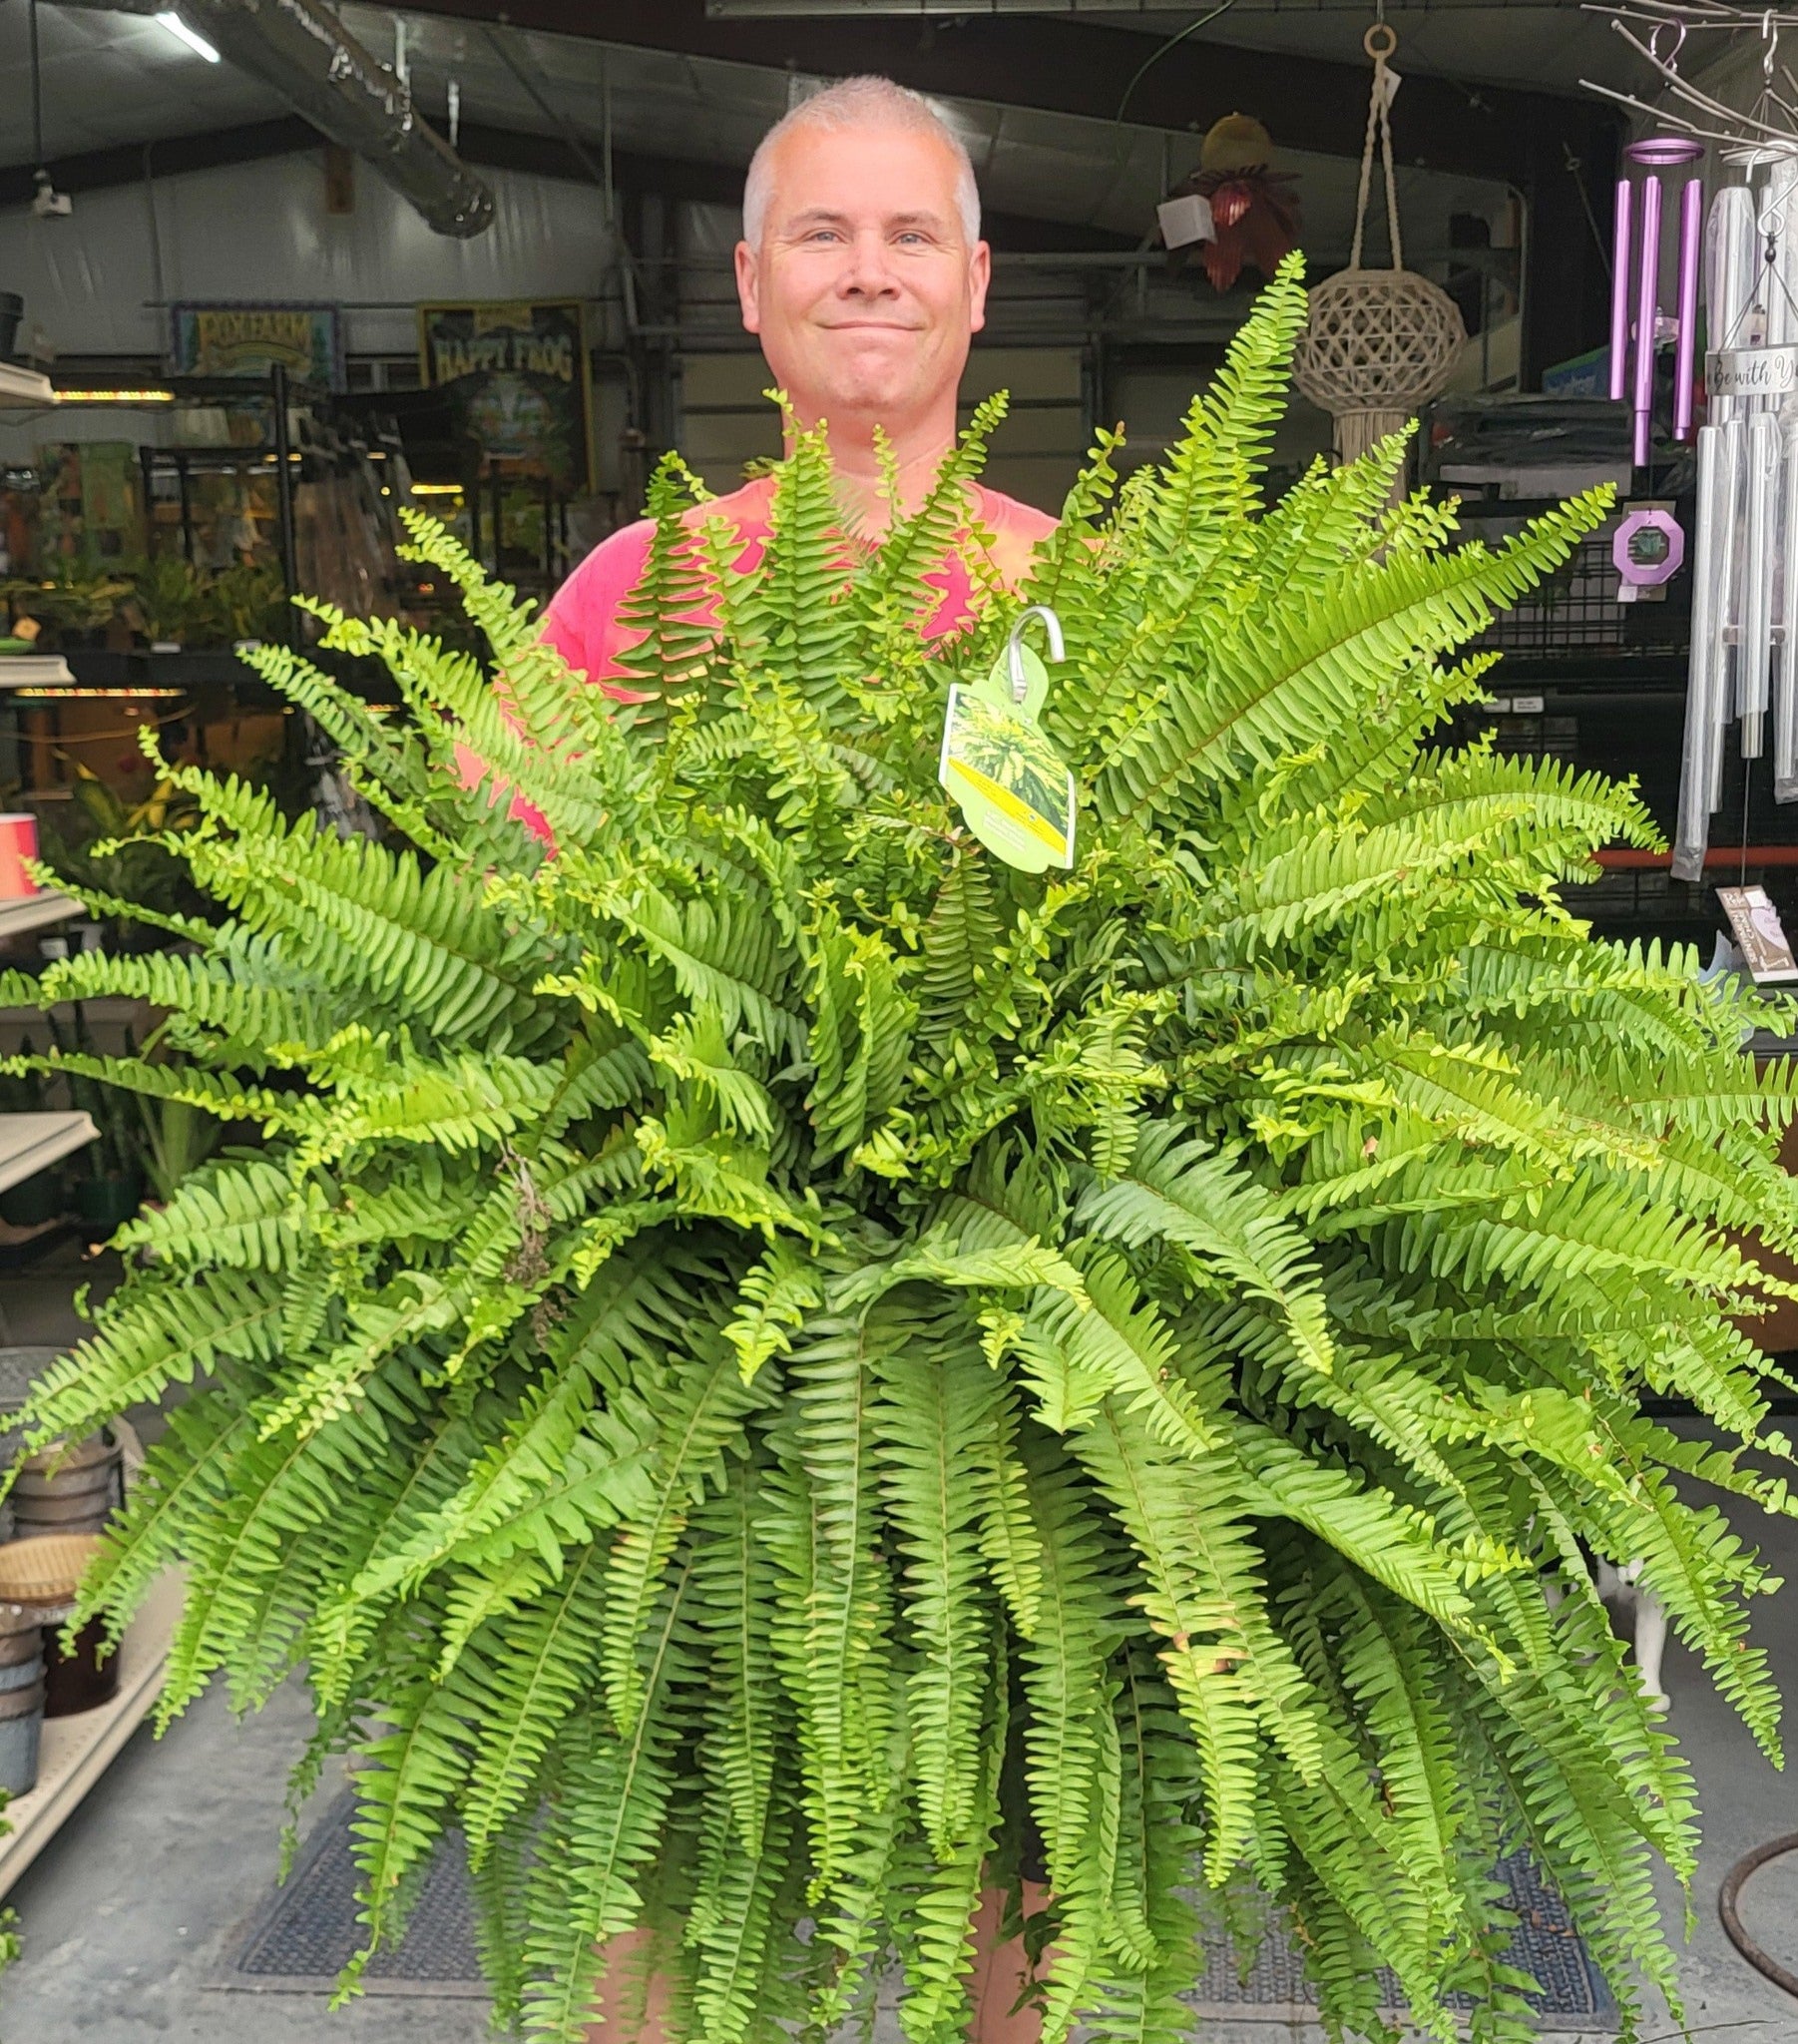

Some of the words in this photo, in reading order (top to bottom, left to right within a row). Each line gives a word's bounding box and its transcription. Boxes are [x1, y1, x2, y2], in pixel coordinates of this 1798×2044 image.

[432, 336, 508, 385] HAPPY
[513, 333, 574, 383] FROG
[1735, 360, 1771, 386] with
